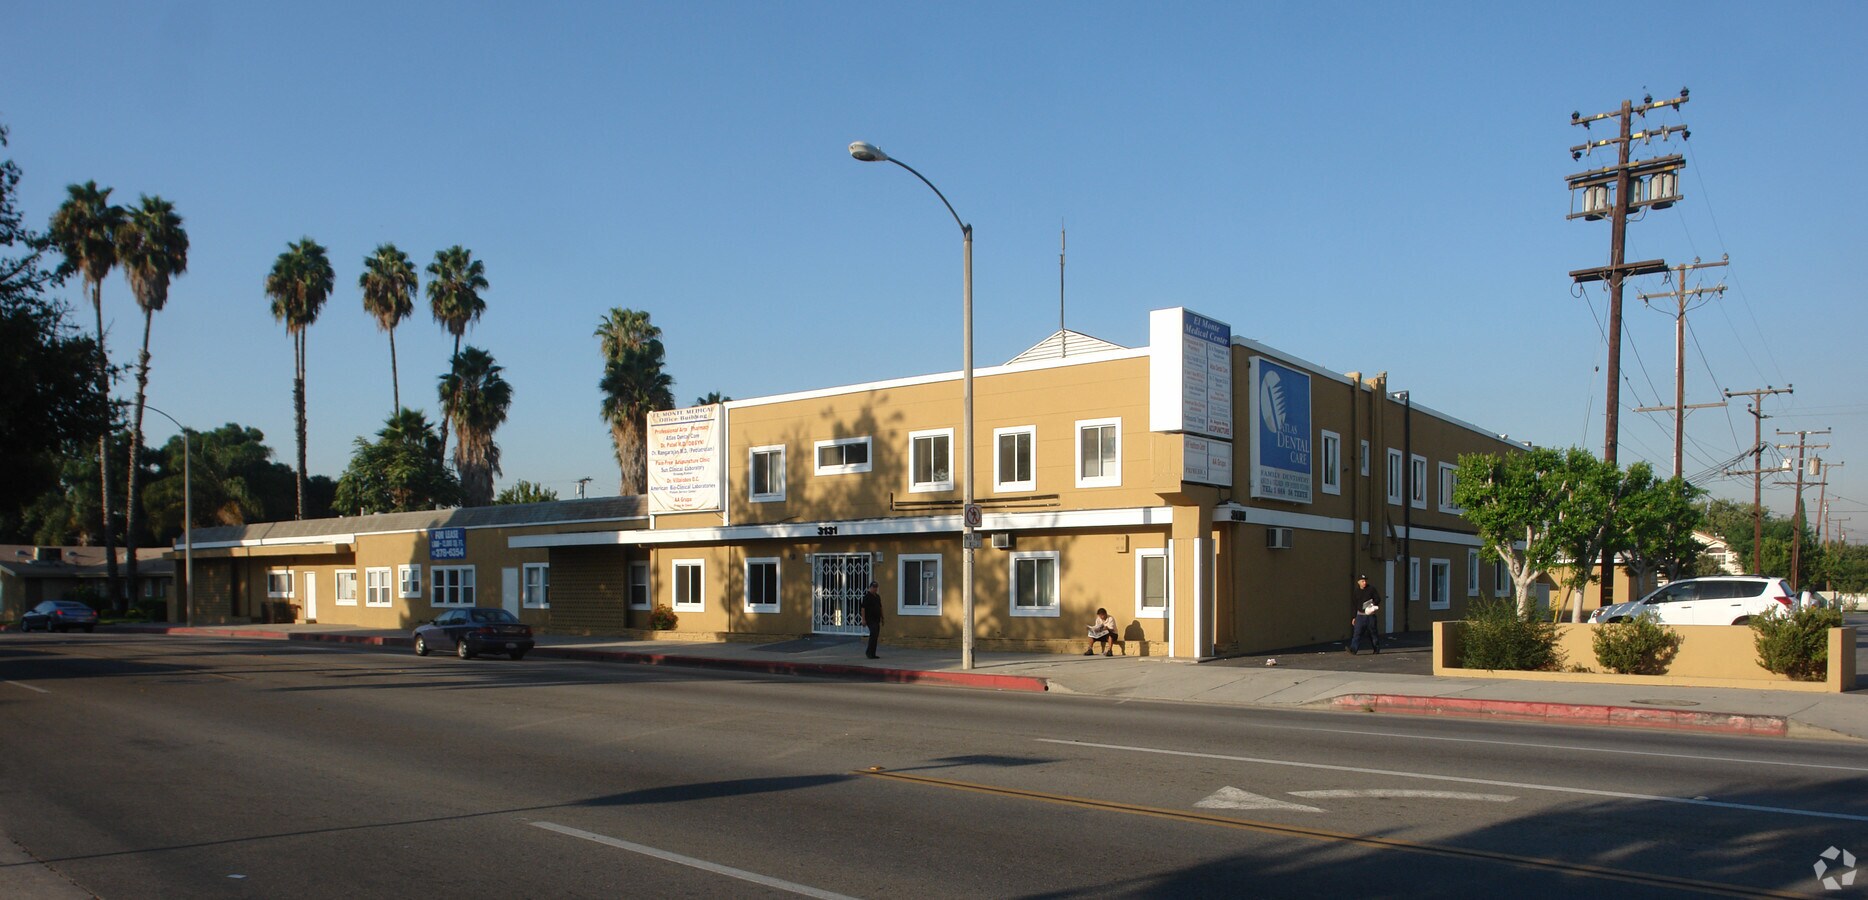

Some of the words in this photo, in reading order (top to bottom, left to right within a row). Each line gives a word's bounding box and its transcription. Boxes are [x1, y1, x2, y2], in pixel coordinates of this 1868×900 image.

[1194, 316, 1201, 324] El
[1202, 320, 1220, 332] Monte
[1185, 324, 1208, 338] Medical
[1210, 332, 1228, 345] Center
[1280, 422, 1297, 434] ATLAS
[1278, 431, 1309, 453] DENTAL
[1290, 451, 1307, 465] CARE
[435, 530, 444, 539] FOR
[445, 530, 458, 538] LEASE
[817, 526, 838, 535] 3131
